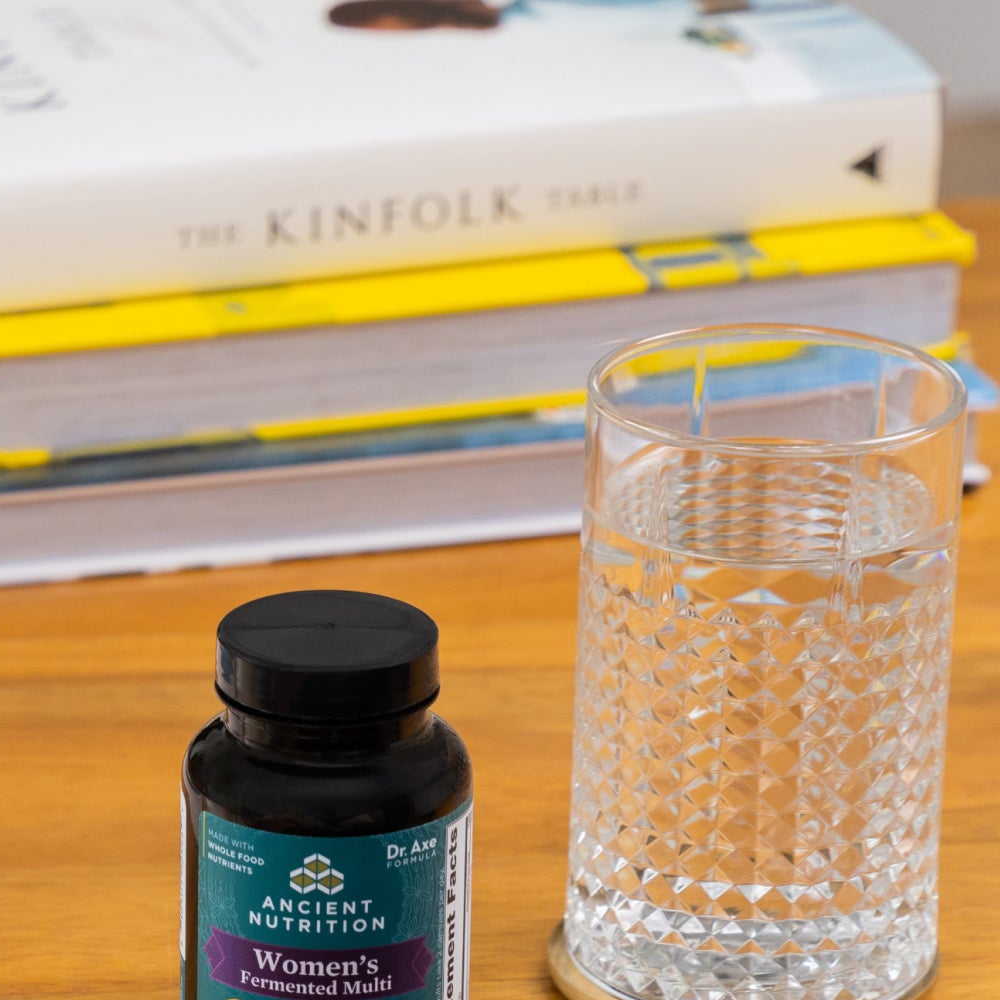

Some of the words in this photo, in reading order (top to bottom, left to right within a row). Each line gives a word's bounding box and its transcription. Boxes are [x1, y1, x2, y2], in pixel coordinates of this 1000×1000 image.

[176, 223, 243, 249] THE
[265, 185, 522, 247] KINFOLK
[547, 180, 643, 210] TABLE
[208, 828, 229, 845] MADE
[231, 838, 254, 852] WITH
[387, 844, 407, 860] Dr.
[410, 837, 438, 855] Axe
[208, 840, 235, 858] WHOLE
[238, 852, 265, 866] FOOD
[208, 852, 253, 875] NUTRIENTS
[387, 849, 437, 869] FORMULA
[446, 827, 458, 905] Facts
[262, 895, 373, 915] ANCIENT
[249, 910, 385, 934] NUTRITION
[252, 948, 379, 977] Women’s
[240, 969, 338, 996] Fermented
[342, 974, 393, 996] Multi
